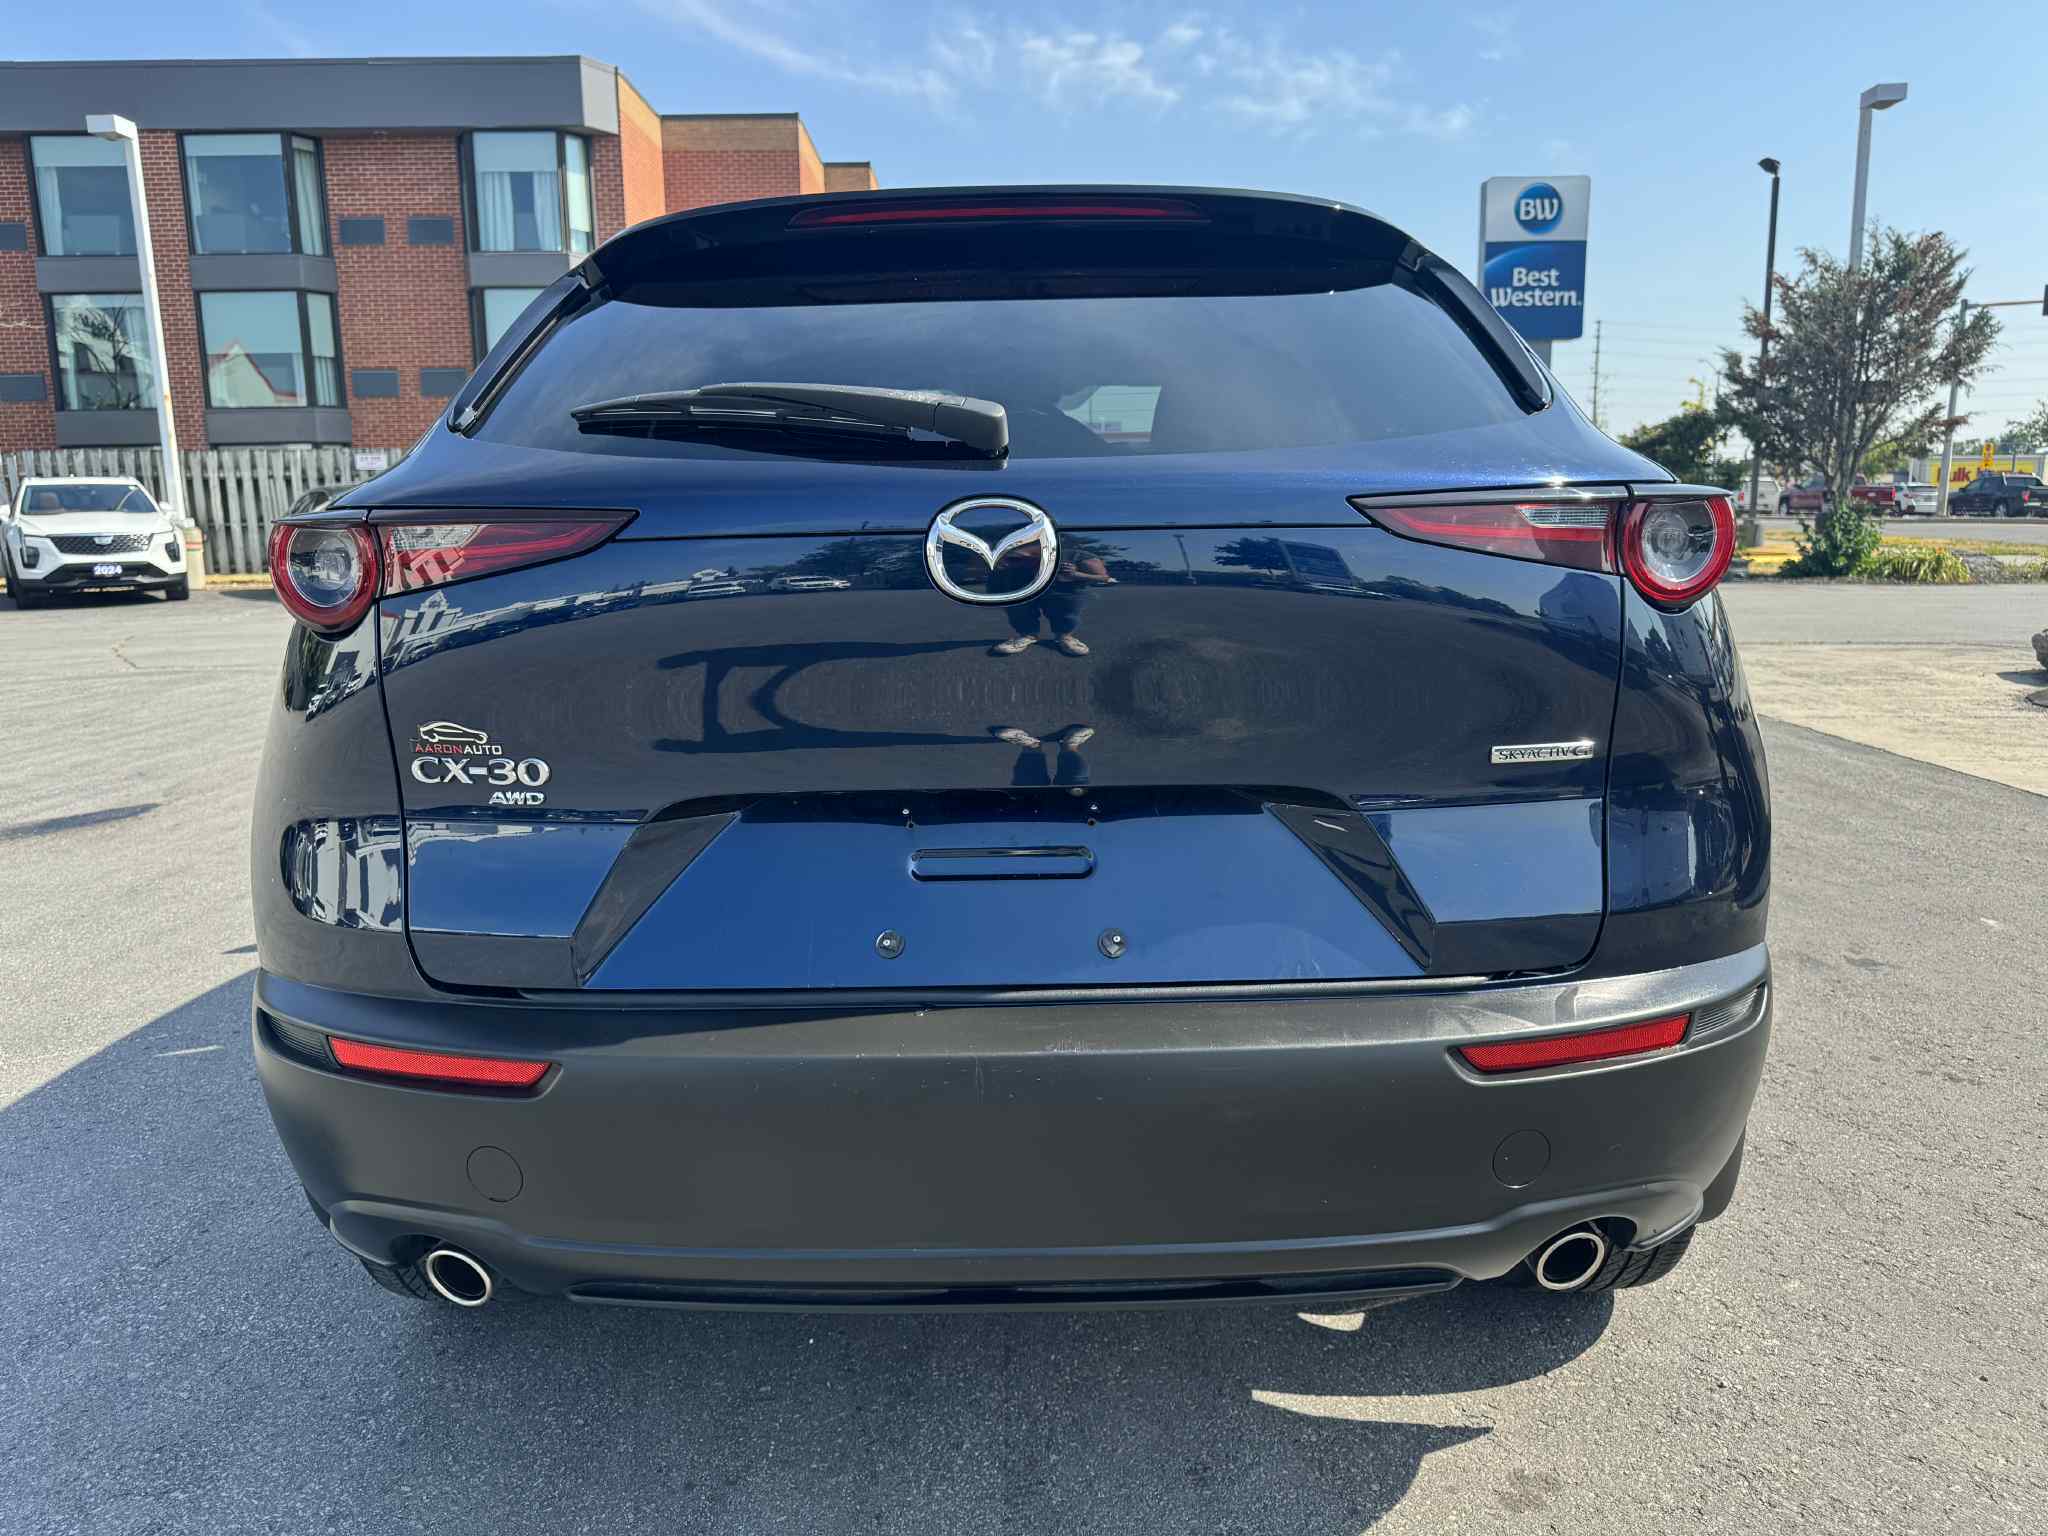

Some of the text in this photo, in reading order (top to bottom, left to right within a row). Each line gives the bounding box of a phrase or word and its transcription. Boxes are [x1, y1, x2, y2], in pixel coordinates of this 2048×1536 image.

[1519, 198, 1559, 220] BW
[1512, 267, 1560, 287] Best
[1490, 287, 1577, 307] Western
[411, 756, 550, 786] CX-30
[488, 791, 545, 805] AWD
